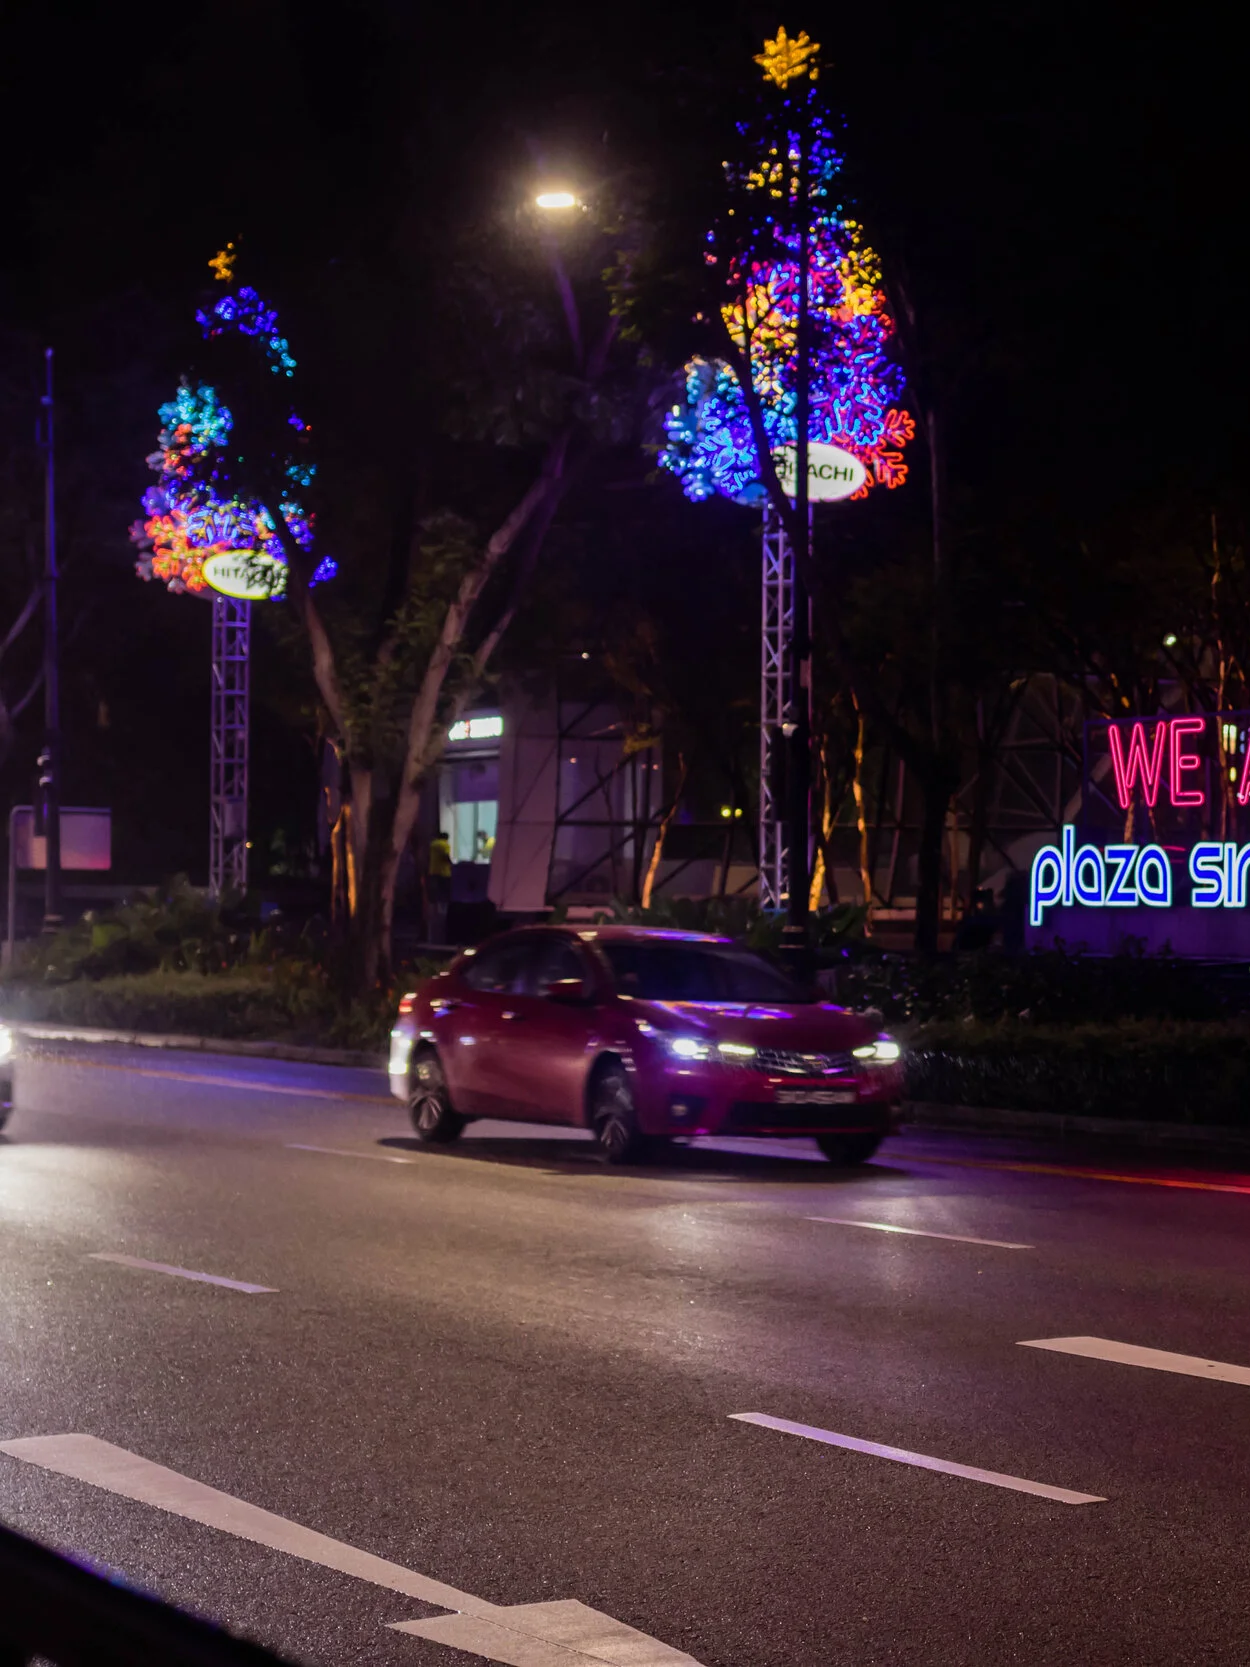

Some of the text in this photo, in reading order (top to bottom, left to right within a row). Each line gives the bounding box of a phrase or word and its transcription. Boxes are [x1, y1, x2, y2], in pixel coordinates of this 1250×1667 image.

[777, 461, 854, 482] IACHI
[1108, 718, 1205, 808] WE
[1030, 825, 1172, 926] plaza
